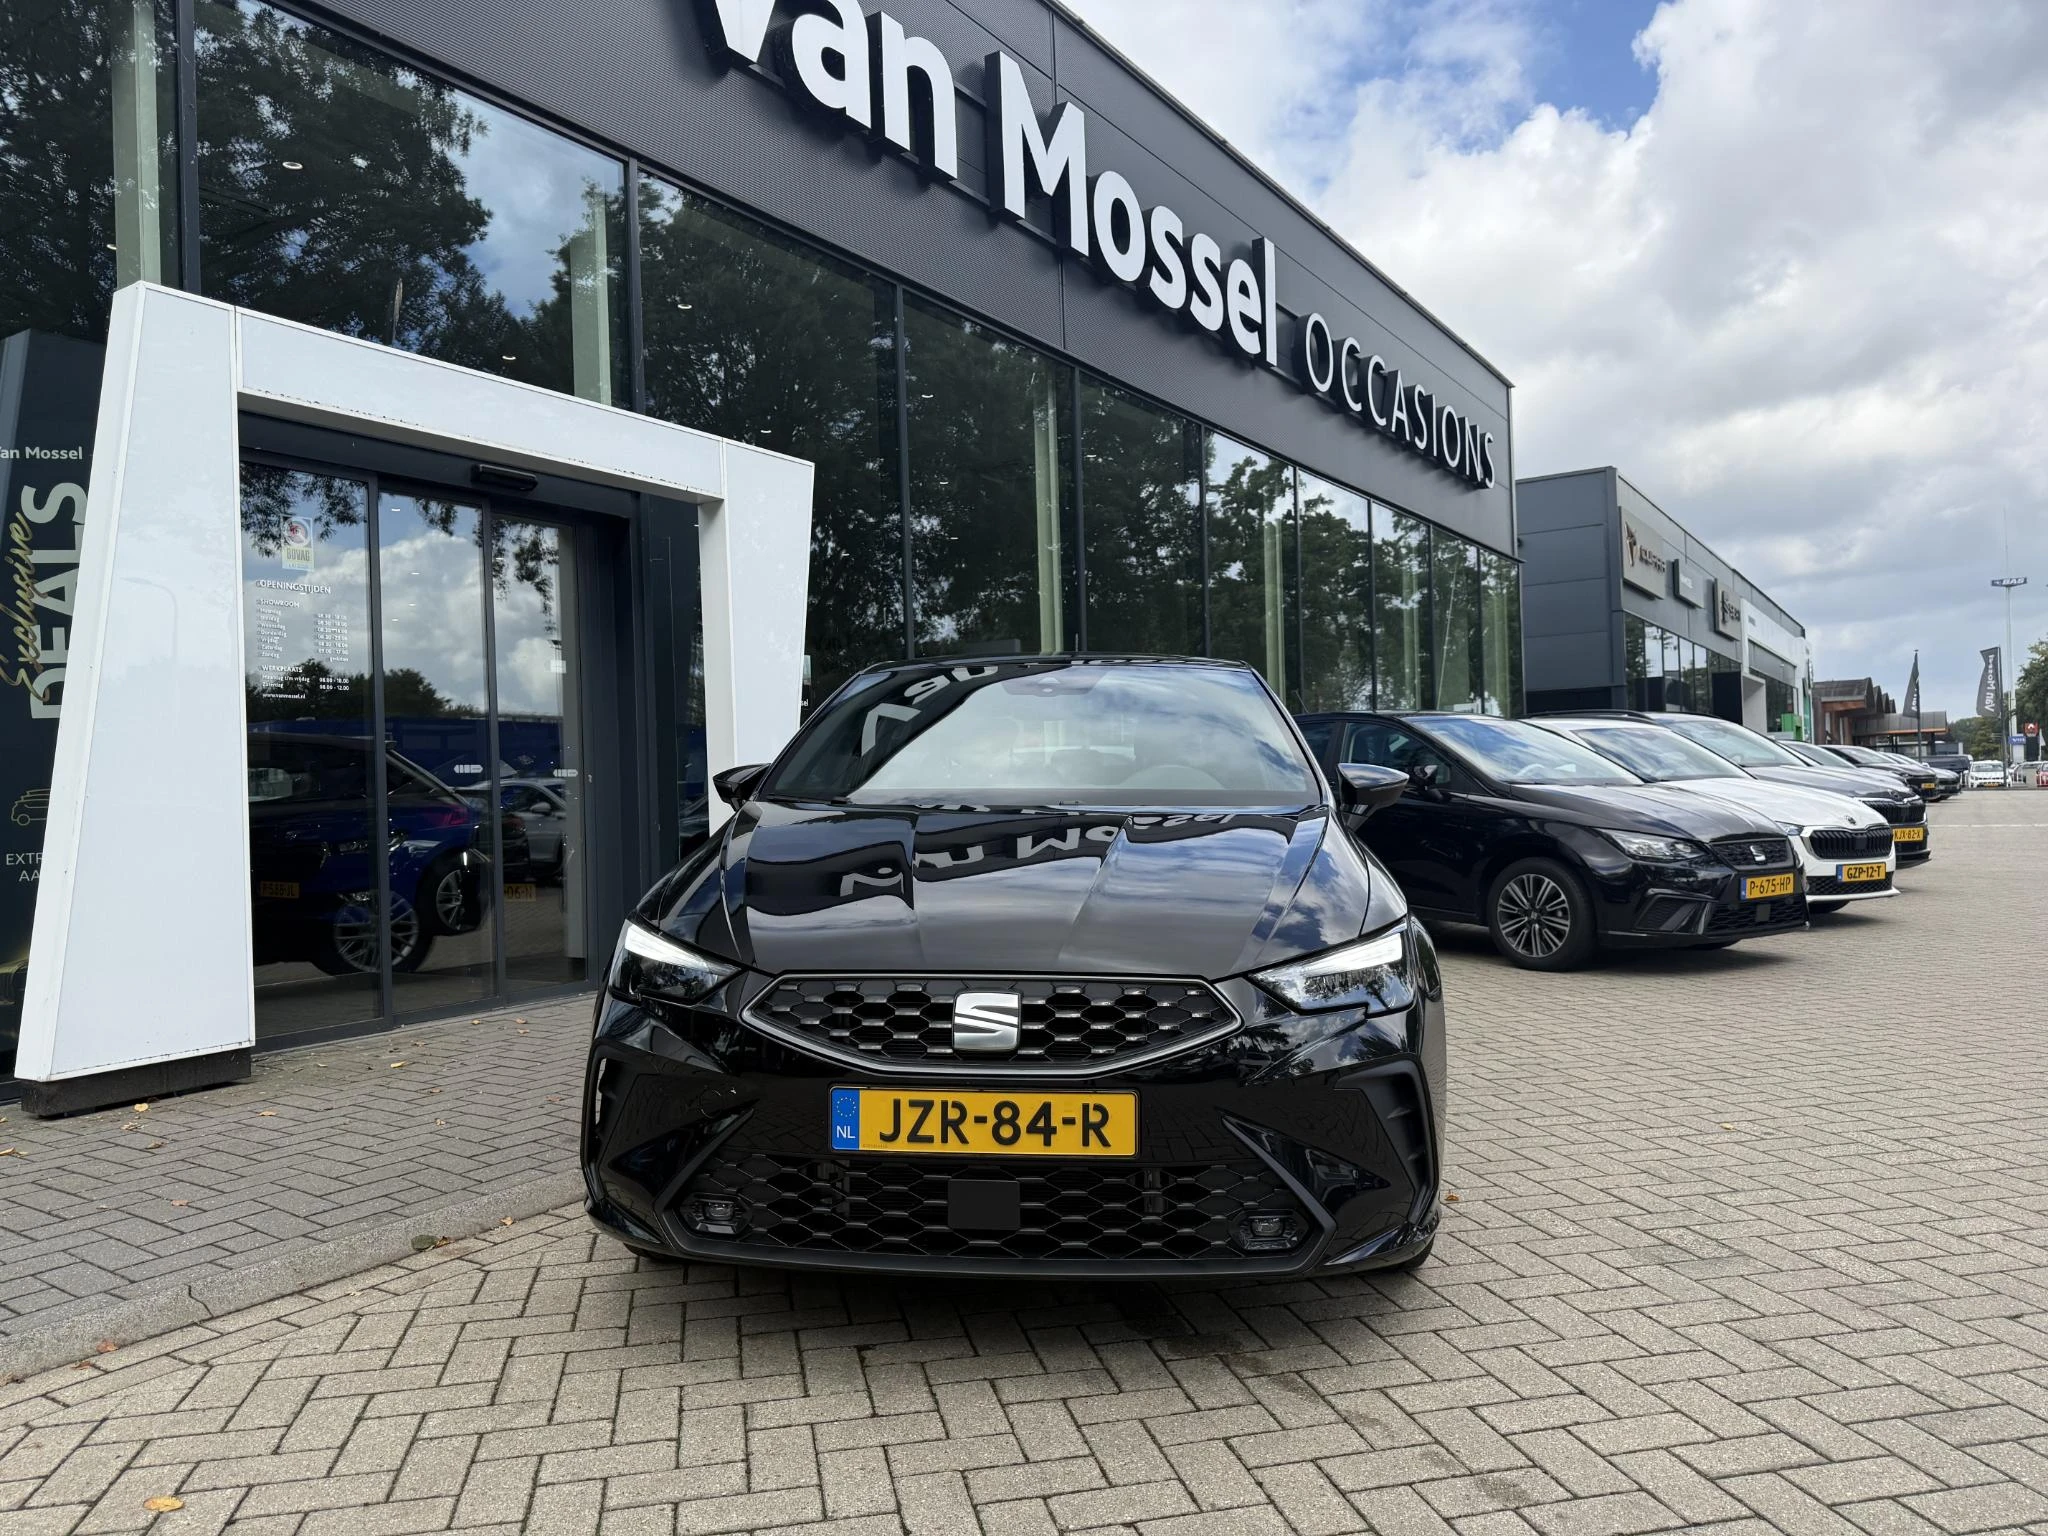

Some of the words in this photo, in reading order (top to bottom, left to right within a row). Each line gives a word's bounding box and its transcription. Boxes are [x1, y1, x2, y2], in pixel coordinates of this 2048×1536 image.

[996, 50, 1278, 368] Mossel
[1301, 312, 1495, 490] OCCASIONS
[25, 446, 83, 460] Mossel
[259, 580, 331, 595] OPENINGSTIJDEN
[1846, 865, 1882, 880] GZP-12-T
[1750, 876, 1791, 896] P-675-HP
[836, 1125, 856, 1139] NL
[879, 1098, 1111, 1148] JZR-84-R
